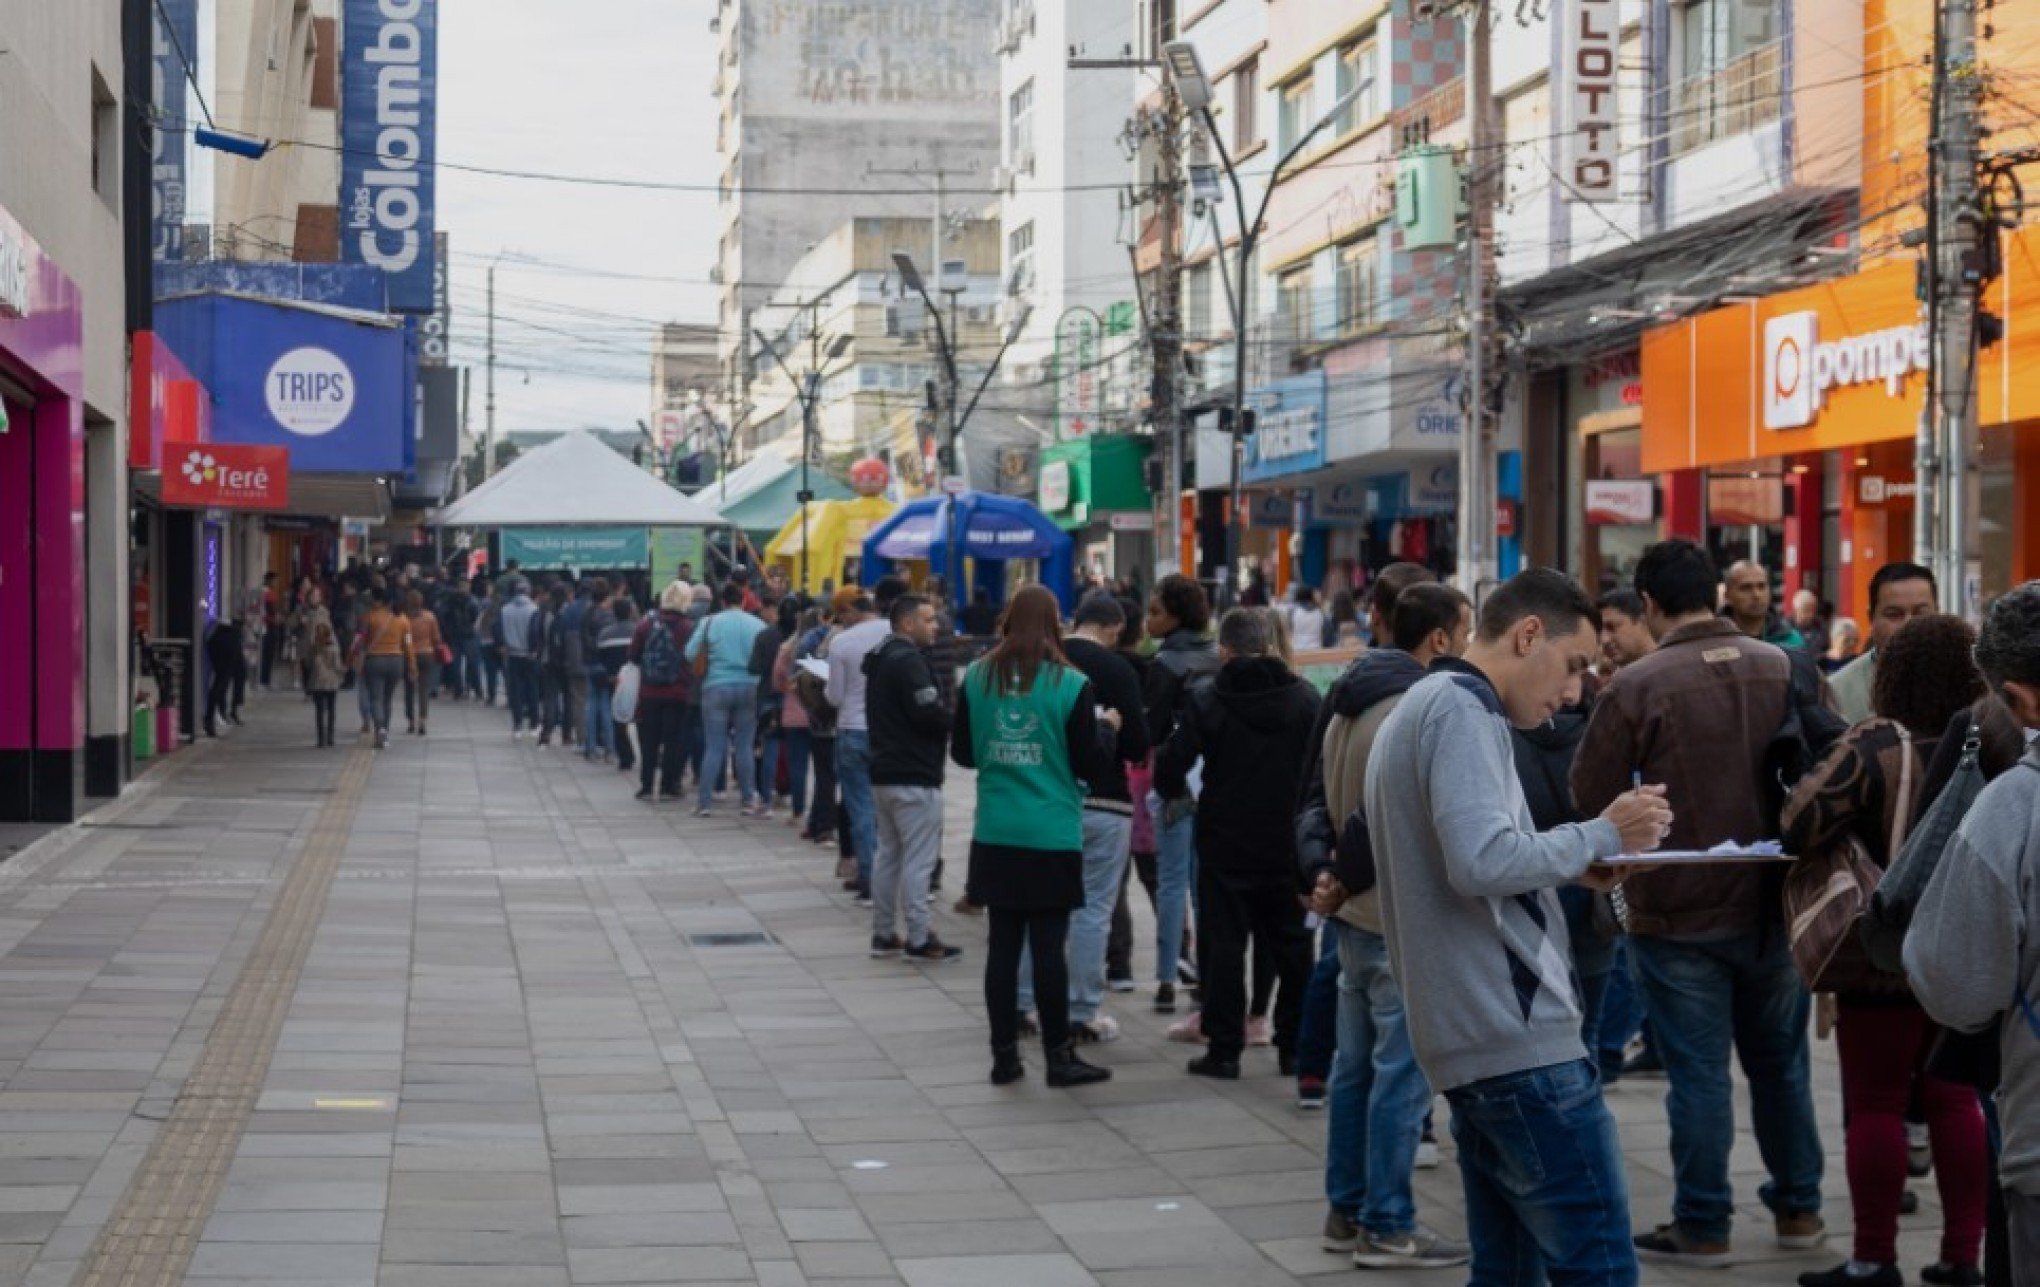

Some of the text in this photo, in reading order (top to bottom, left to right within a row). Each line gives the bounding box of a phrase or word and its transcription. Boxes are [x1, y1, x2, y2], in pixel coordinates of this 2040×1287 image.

[1576, 0, 1613, 189] LOTTO
[275, 372, 345, 402] TRIPS
[1416, 415, 1461, 434] ORIE
[217, 466, 270, 489] Terê
